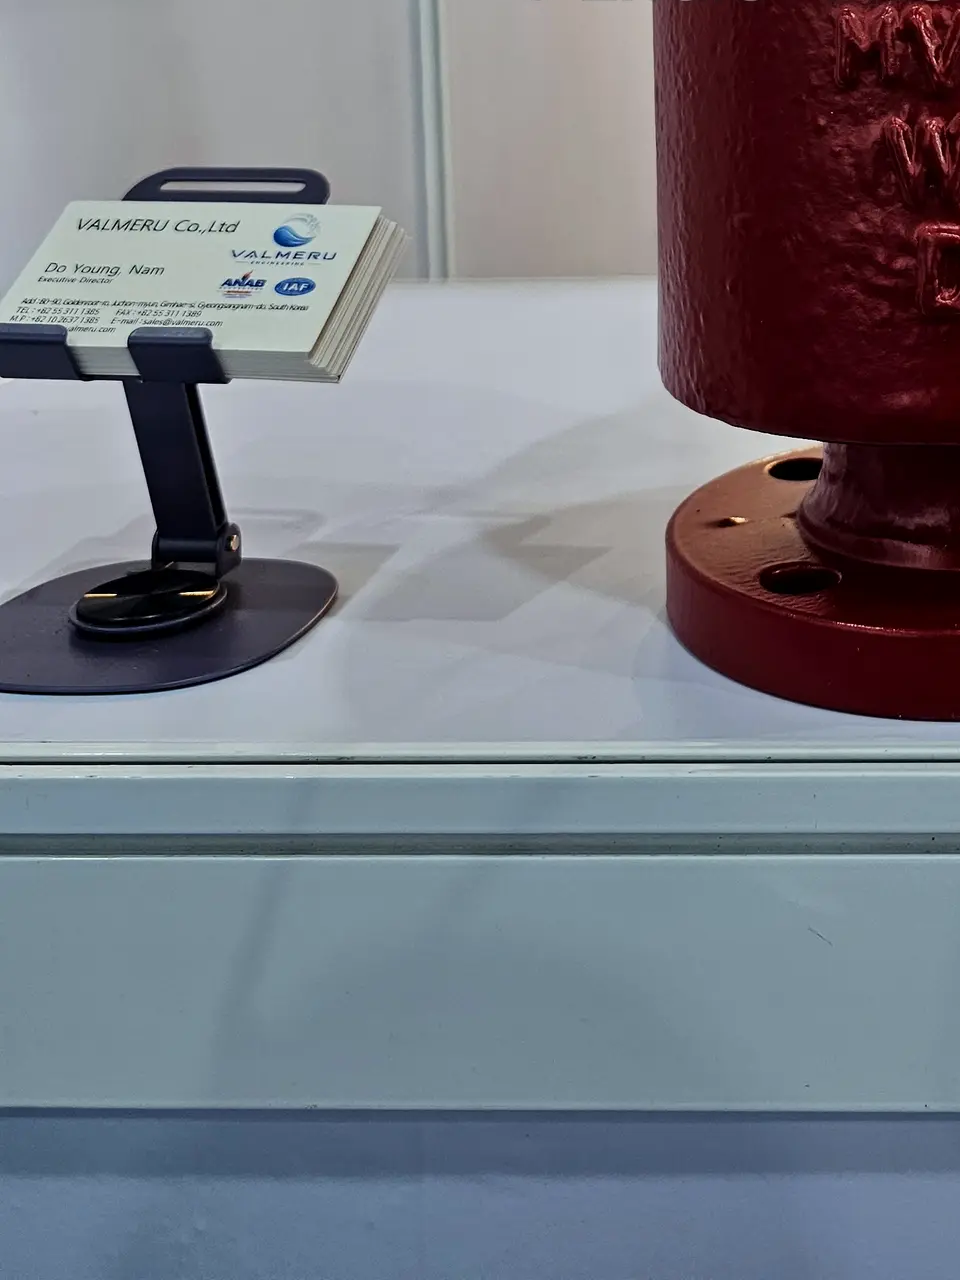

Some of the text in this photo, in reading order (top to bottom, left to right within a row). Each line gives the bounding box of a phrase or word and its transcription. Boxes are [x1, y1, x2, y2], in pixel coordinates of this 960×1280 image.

[77, 218, 241, 235] VALMERU Co.,Ltd
[231, 249, 337, 261] VALMERU
[44, 262, 165, 277] Do Young, Nam
[37, 276, 77, 284] Executive
[220, 278, 267, 288] ANAB
[283, 282, 309, 292] IAF
